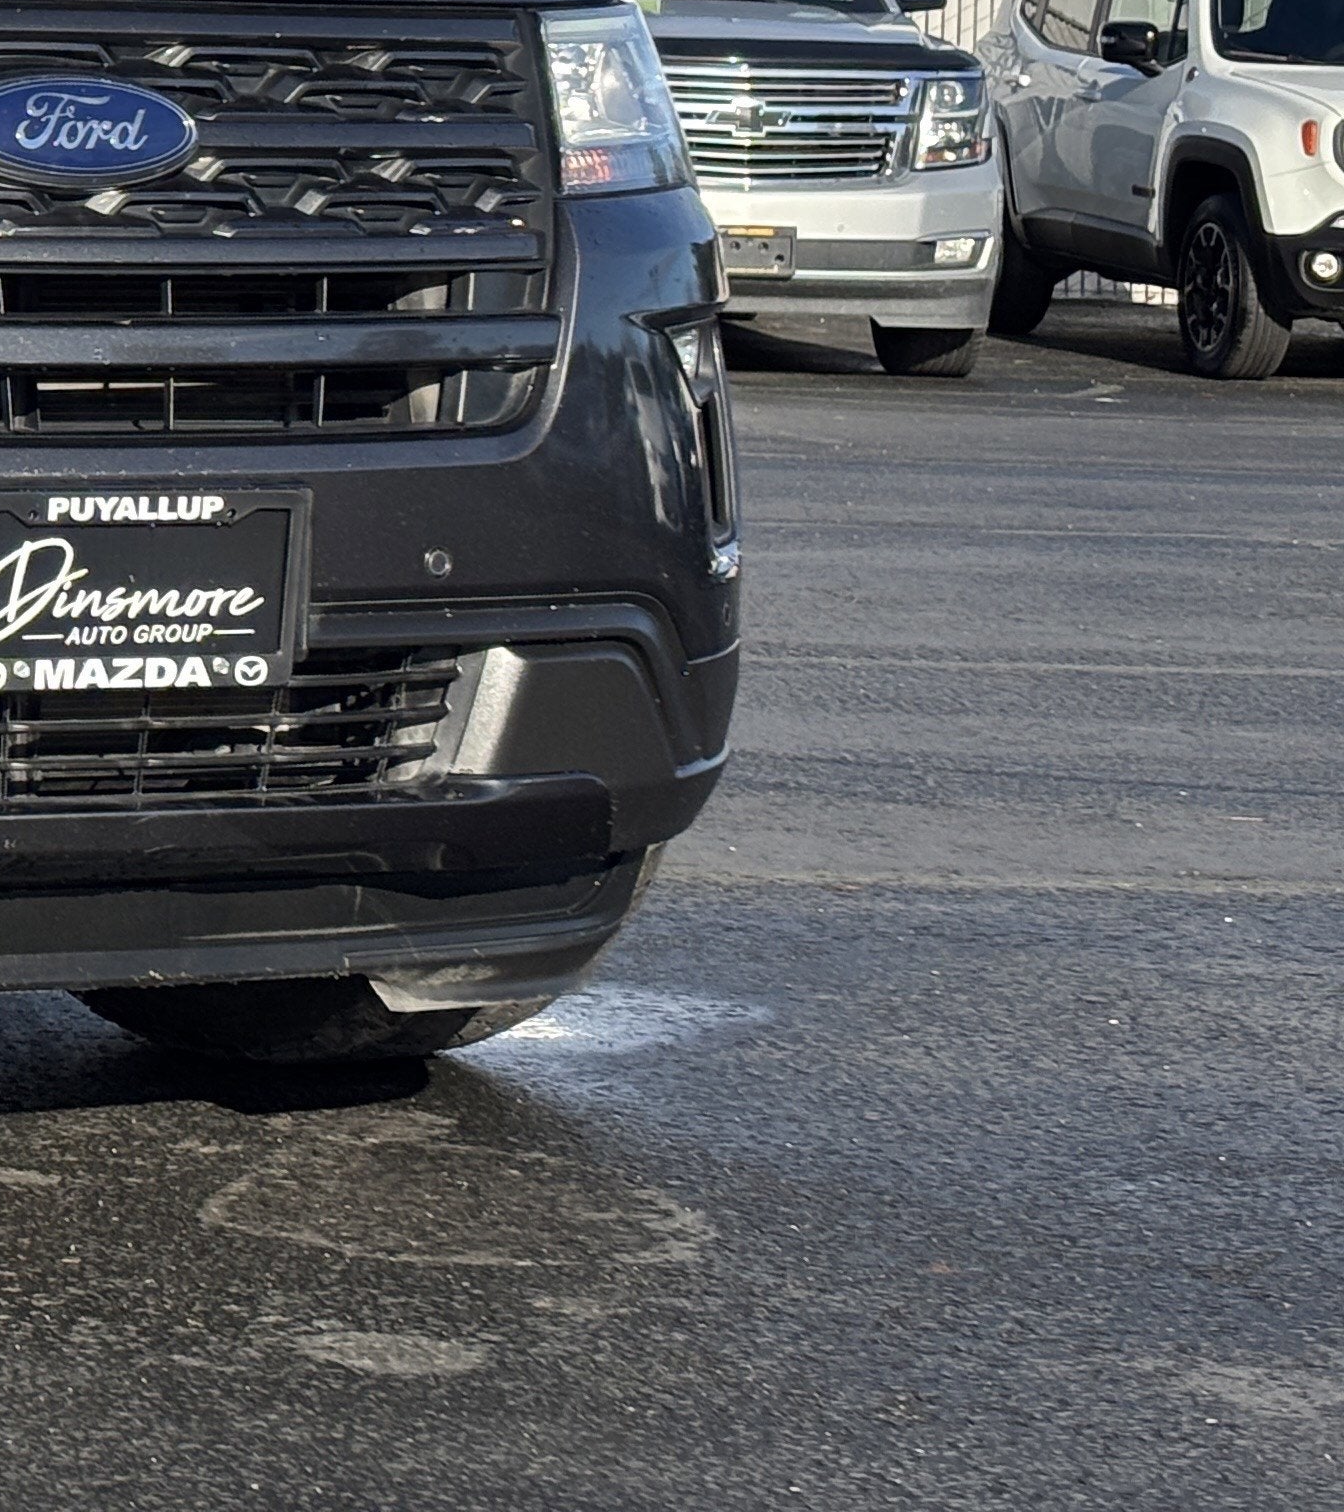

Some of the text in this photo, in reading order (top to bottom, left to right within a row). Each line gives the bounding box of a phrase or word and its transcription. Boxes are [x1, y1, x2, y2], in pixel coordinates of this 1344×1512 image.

[15, 92, 149, 151] Ford
[46, 495, 226, 522] PUYALLUP
[64, 623, 214, 646] AUTO GROUP
[33, 656, 212, 691] MAZDA
